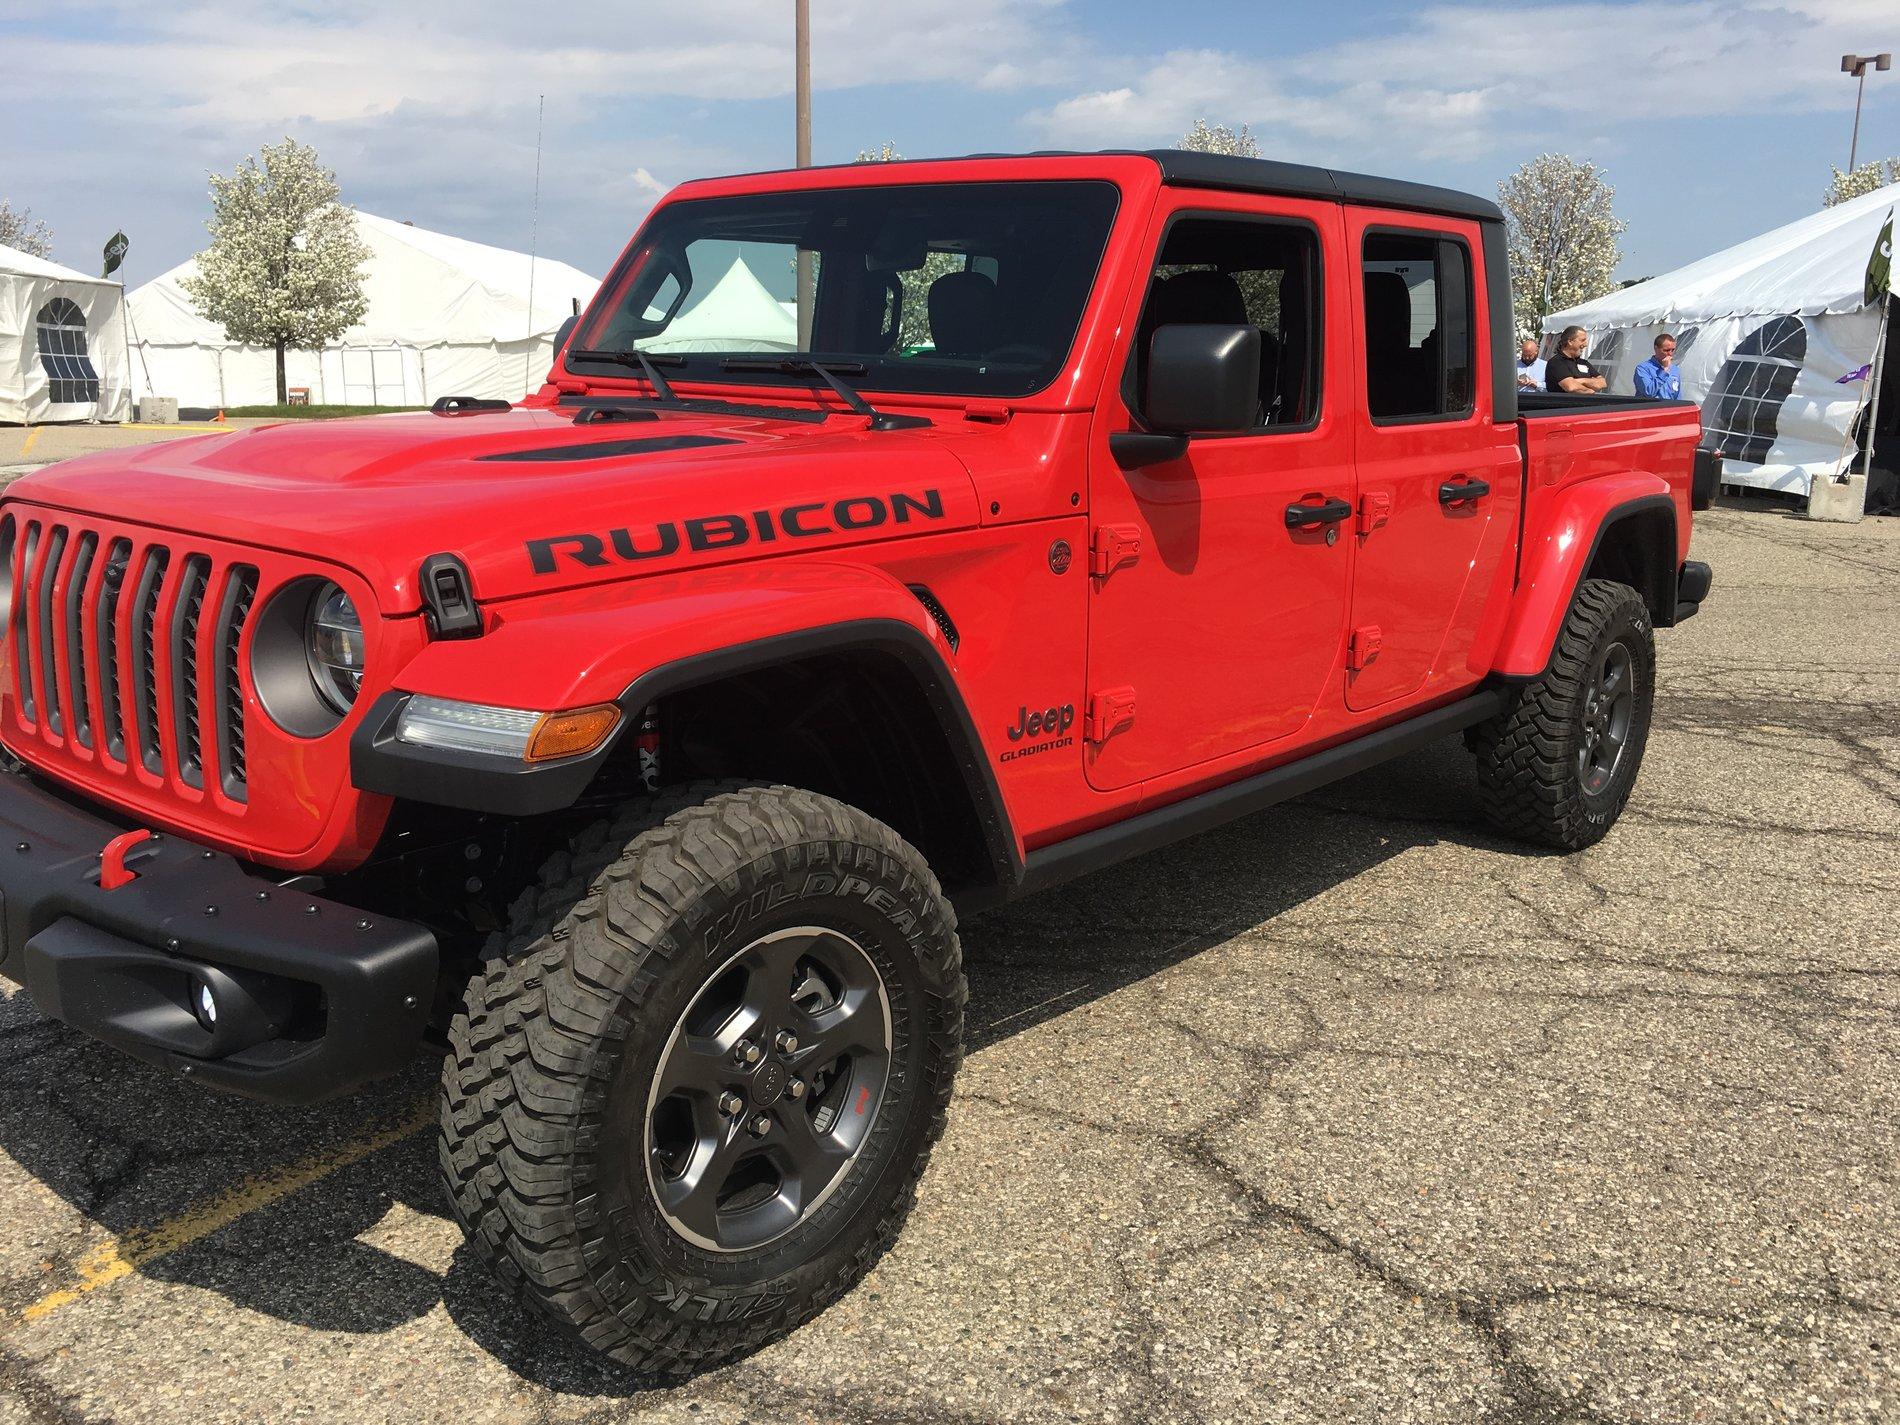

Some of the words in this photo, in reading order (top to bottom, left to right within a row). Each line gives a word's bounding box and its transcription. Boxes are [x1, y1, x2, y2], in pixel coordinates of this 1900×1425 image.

[526, 489, 944, 575] RUBICON
[1007, 704, 1075, 742] Jeep
[1000, 737, 1073, 762] GLADIATOR
